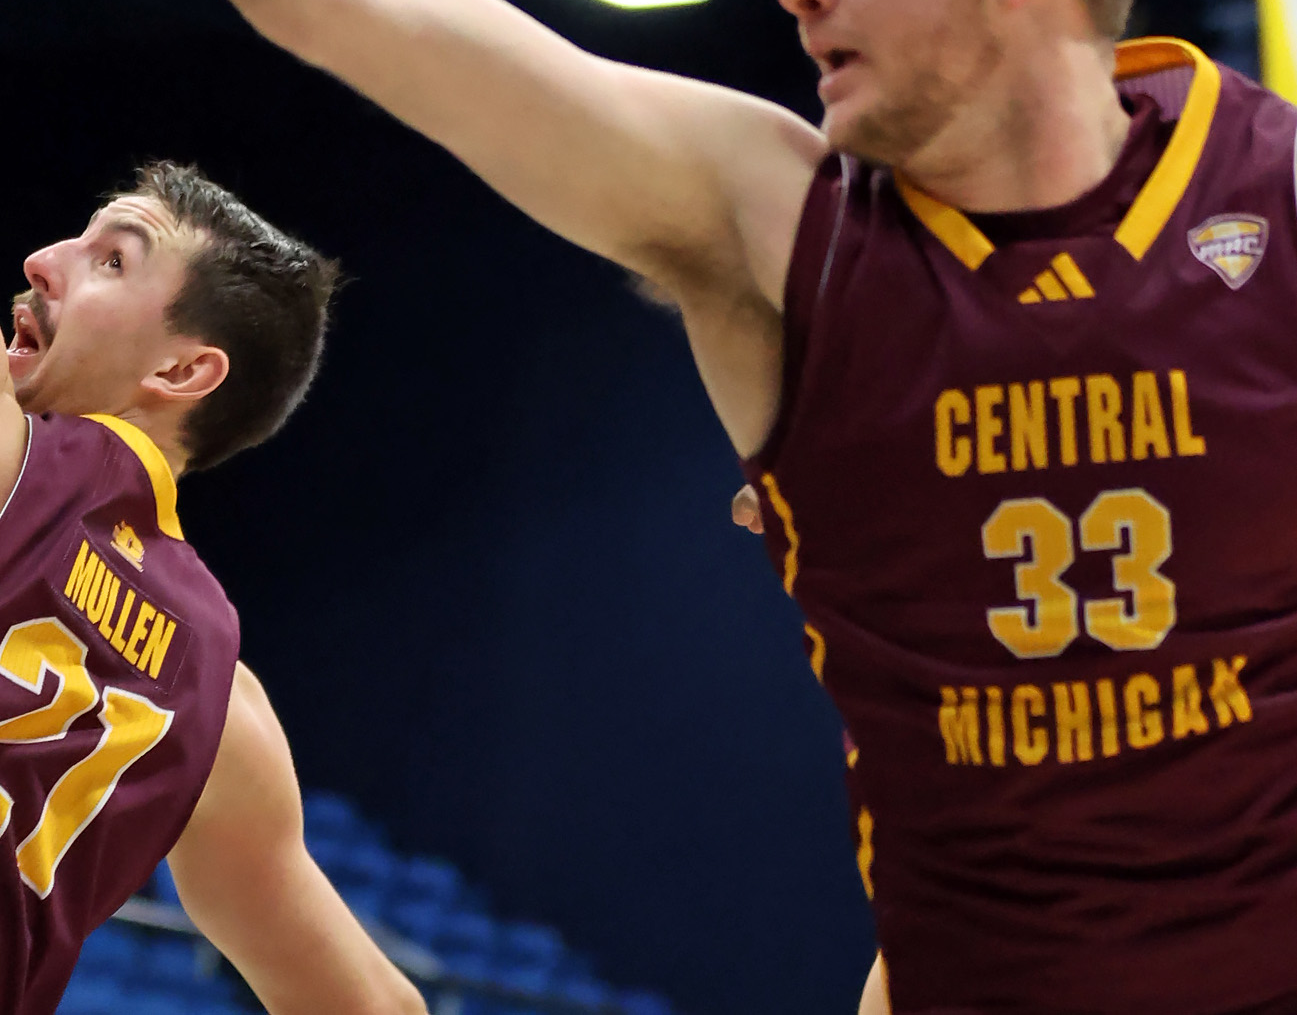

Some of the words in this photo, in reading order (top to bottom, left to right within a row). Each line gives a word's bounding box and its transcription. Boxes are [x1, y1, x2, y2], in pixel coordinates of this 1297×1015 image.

[935, 369, 1206, 477] CENTRAL
[64, 539, 176, 680] MULLEN
[982, 487, 1176, 659] 33
[938, 655, 1252, 766] MICHIGAN
